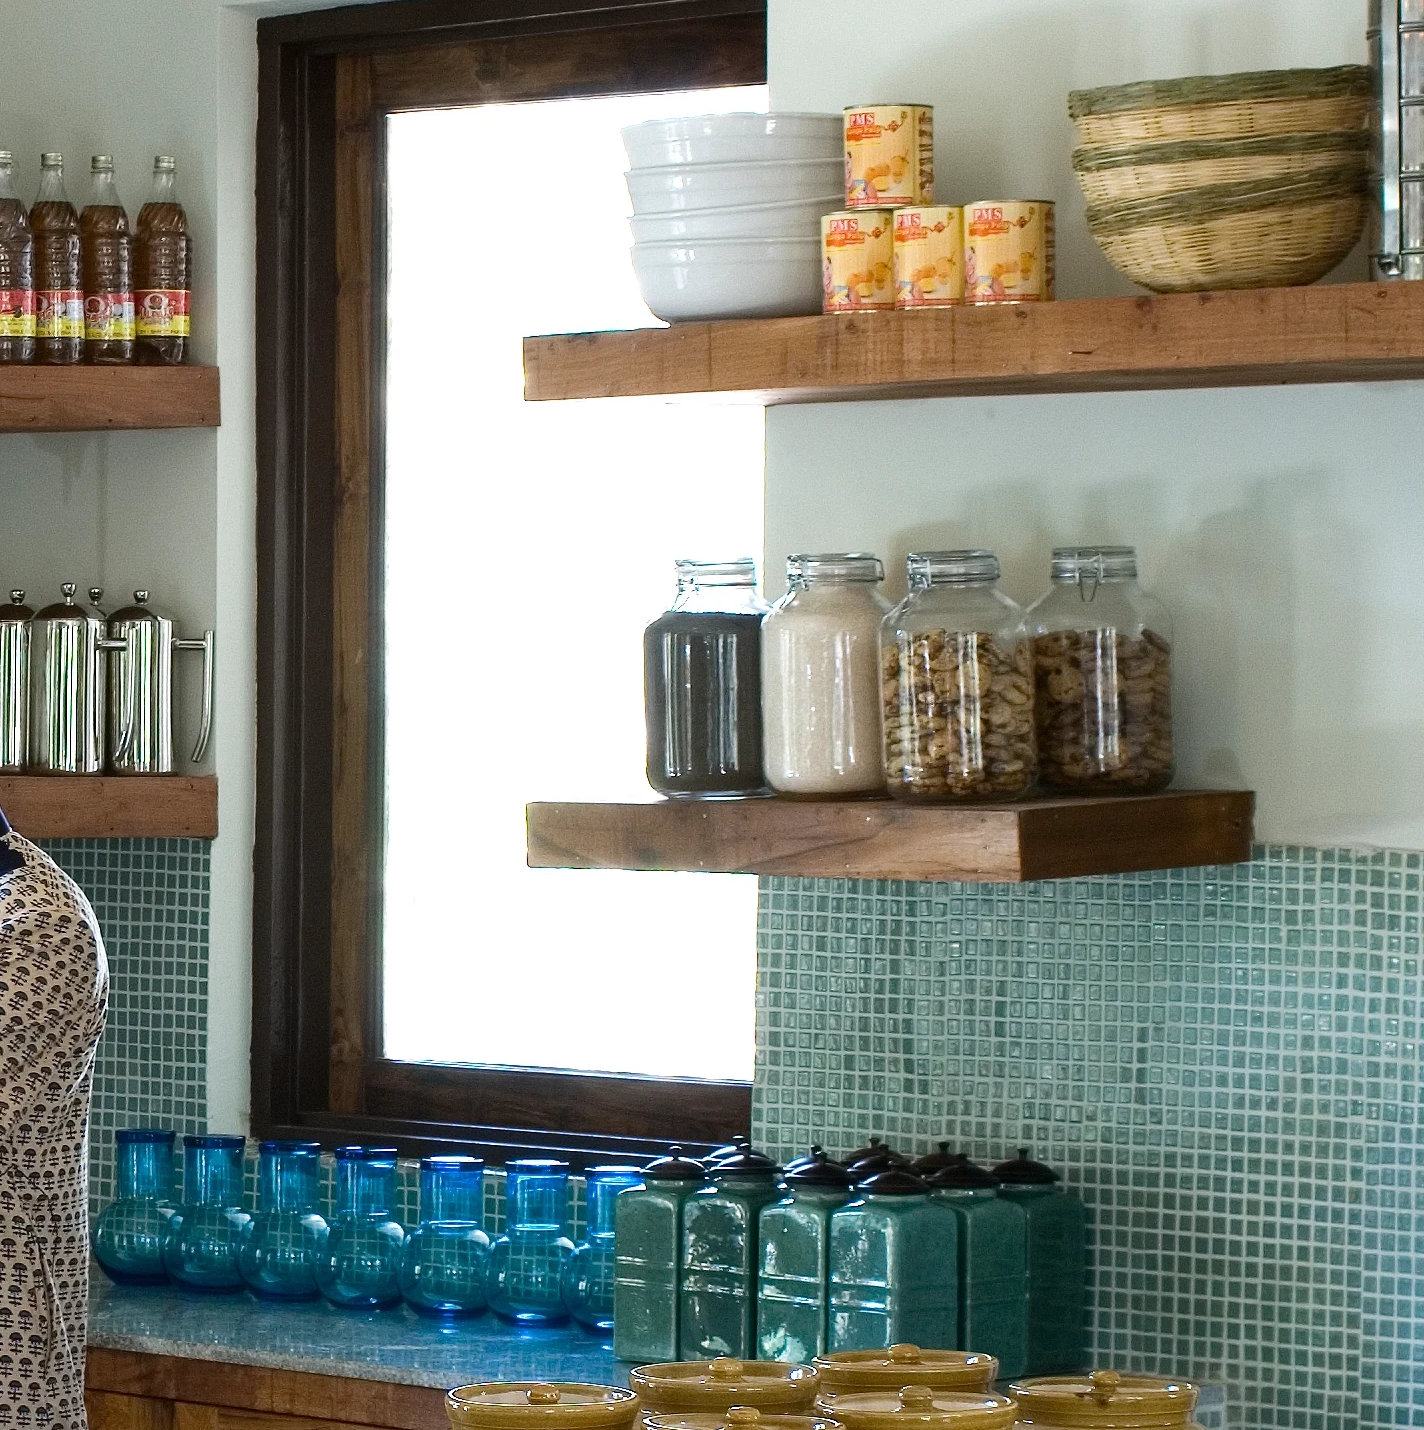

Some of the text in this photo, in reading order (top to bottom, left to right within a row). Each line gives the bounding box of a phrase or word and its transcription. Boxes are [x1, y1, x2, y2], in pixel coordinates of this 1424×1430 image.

[850, 113, 874, 126] PMS
[896, 214, 921, 227] PMS
[974, 208, 1002, 221] PMS
[830, 219, 858, 232] PMS
